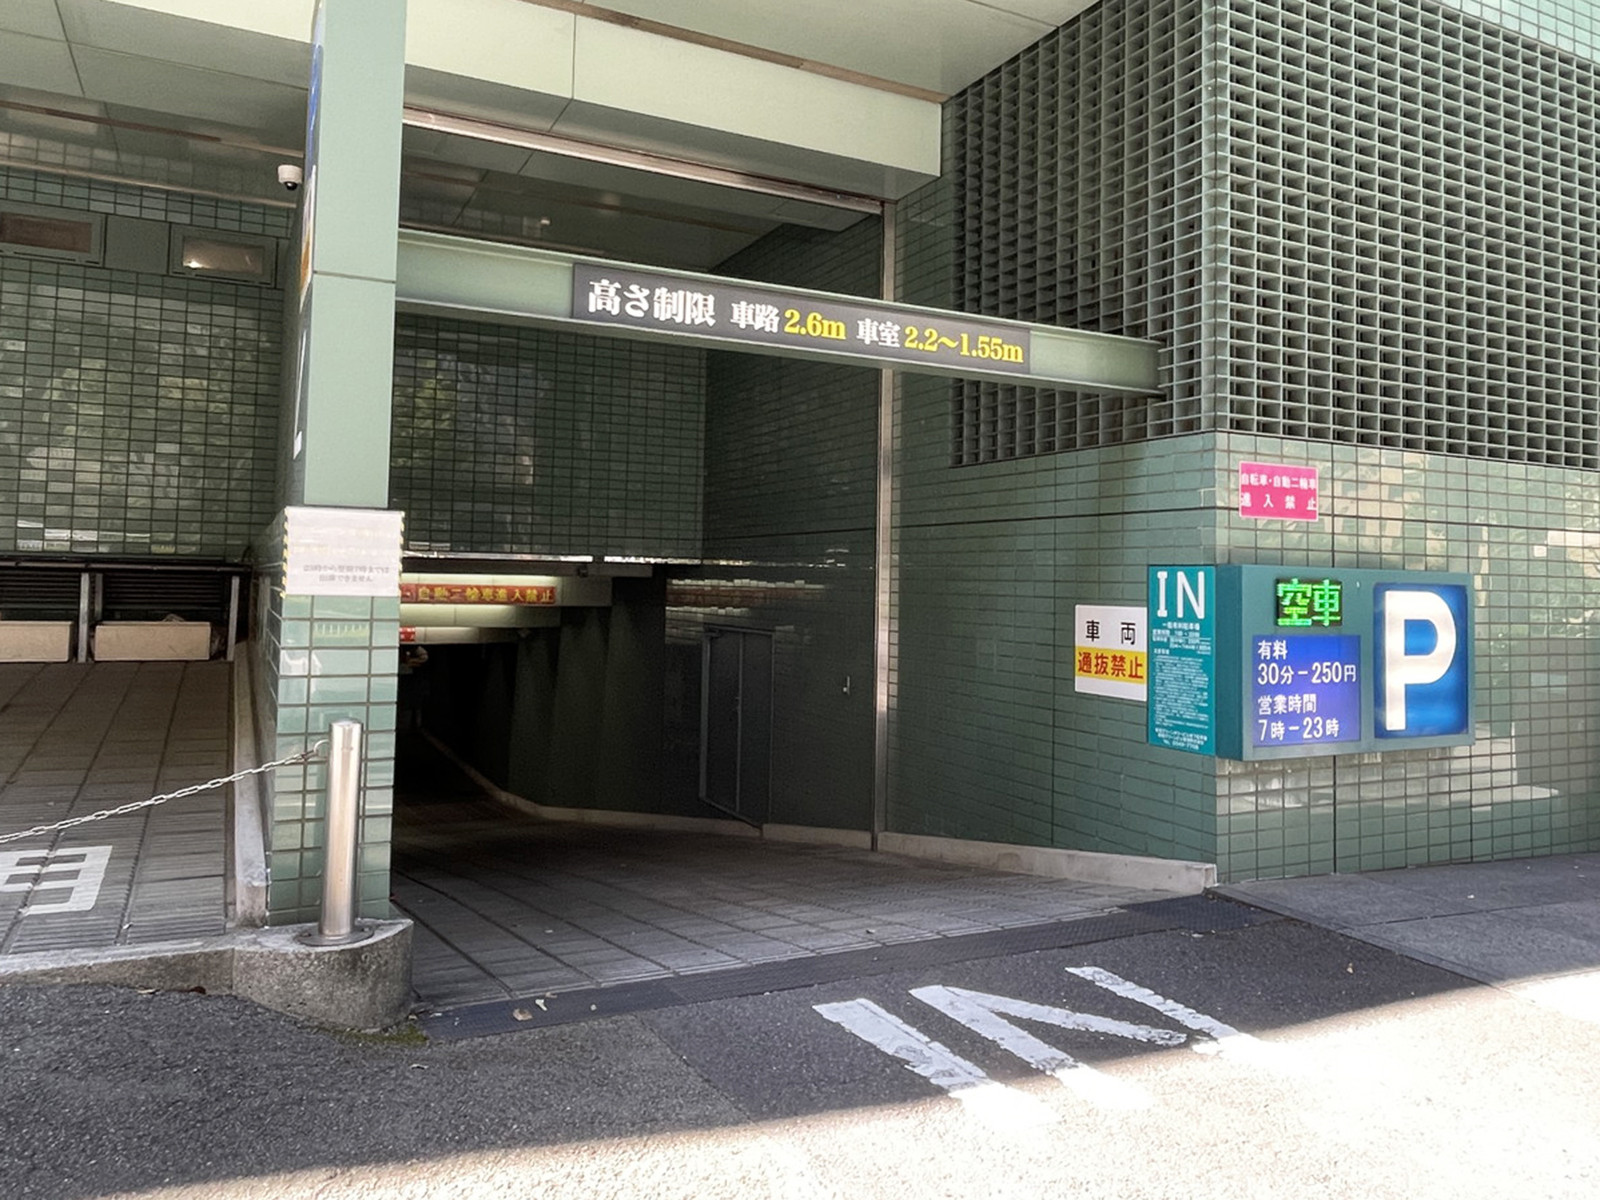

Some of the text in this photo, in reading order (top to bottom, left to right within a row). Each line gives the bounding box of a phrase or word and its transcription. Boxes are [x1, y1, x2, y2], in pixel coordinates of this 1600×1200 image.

[588, 279, 716, 327] 高さ制限
[1156, 570, 1205, 620] IN
[1276, 578, 1342, 627] 空車
[1077, 651, 1144, 680] 通抜禁止
[1257, 640, 1288, 660] 有料
[1384, 590, 1457, 731] P
[1257, 694, 1317, 714] 営業時間
